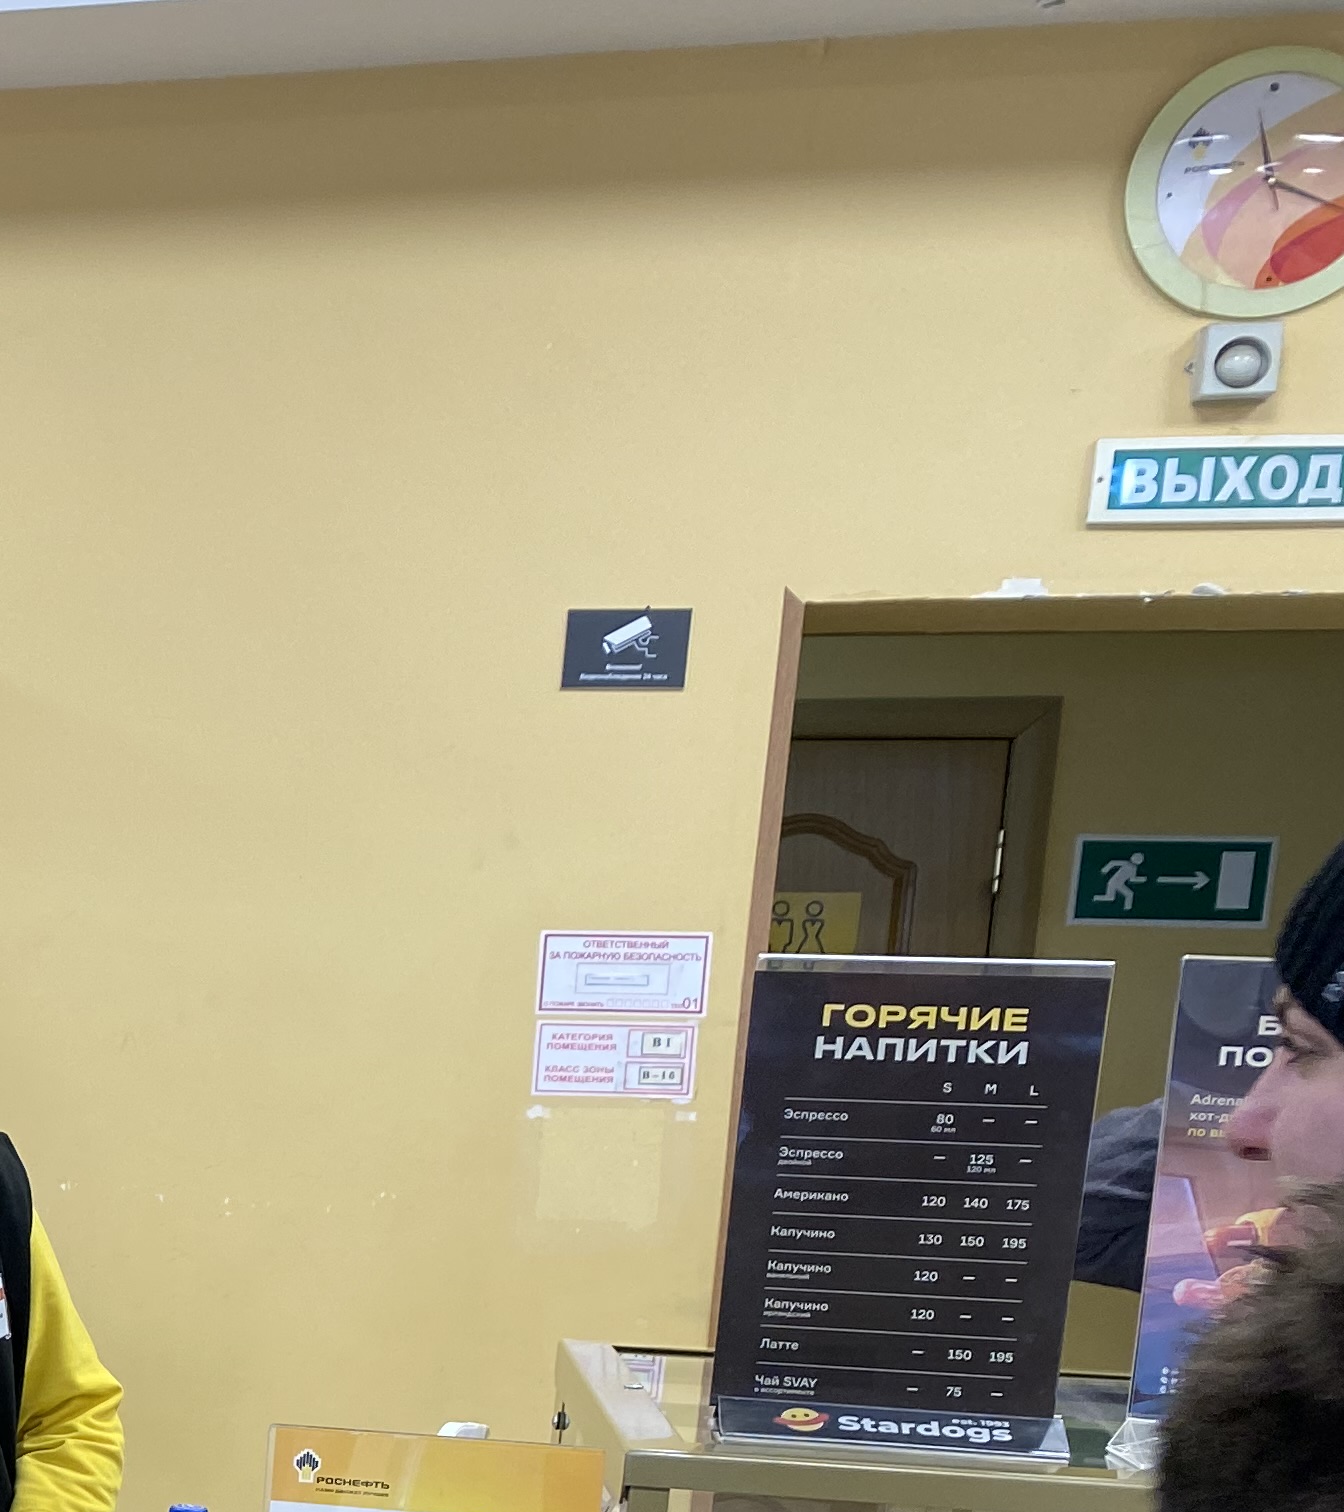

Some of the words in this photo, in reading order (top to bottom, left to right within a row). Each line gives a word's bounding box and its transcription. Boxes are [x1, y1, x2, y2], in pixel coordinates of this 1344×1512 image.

[1123, 455, 1344, 507] ВЫХОД
[583, 940, 669, 949] ОТВЕТСТВЕННЫЙ
[564, 952, 621, 961] ПОЖАРНУЮ
[624, 953, 701, 962] БЕЗОПАСНОСТЬ
[821, 1003, 1030, 1032] ГОРЯЧИЕ
[547, 1043, 617, 1051] ПОМЕЩЕНИЯ
[814, 1037, 1030, 1066] НАПИТКИ
[943, 1083, 953, 1094] S
[985, 1083, 997, 1095] M
[1030, 1086, 1039, 1096] L
[784, 1109, 849, 1123] Эспрессо
[936, 1113, 954, 1125] 80
[779, 1147, 843, 1162] Эспрессо
[969, 1154, 994, 1166] 125
[774, 1189, 849, 1203] Американо
[921, 1195, 946, 1208] 120
[963, 1197, 989, 1209] 140
[1006, 1199, 1030, 1211] 175
[771, 1226, 835, 1240] Капучино
[918, 1233, 943, 1246] 130
[960, 1235, 984, 1248] 150
[1002, 1237, 1027, 1250] 195
[760, 1338, 799, 1351] Латте
[947, 1349, 972, 1362] 150
[989, 1351, 1014, 1364] 195
[754, 1375, 780, 1388] Чай
[783, 1376, 818, 1389] SVAY
[946, 1386, 962, 1398] 75
[838, 1415, 1013, 1443] Stardogs
[316, 1476, 390, 1489] РОСНЕФТЬ
